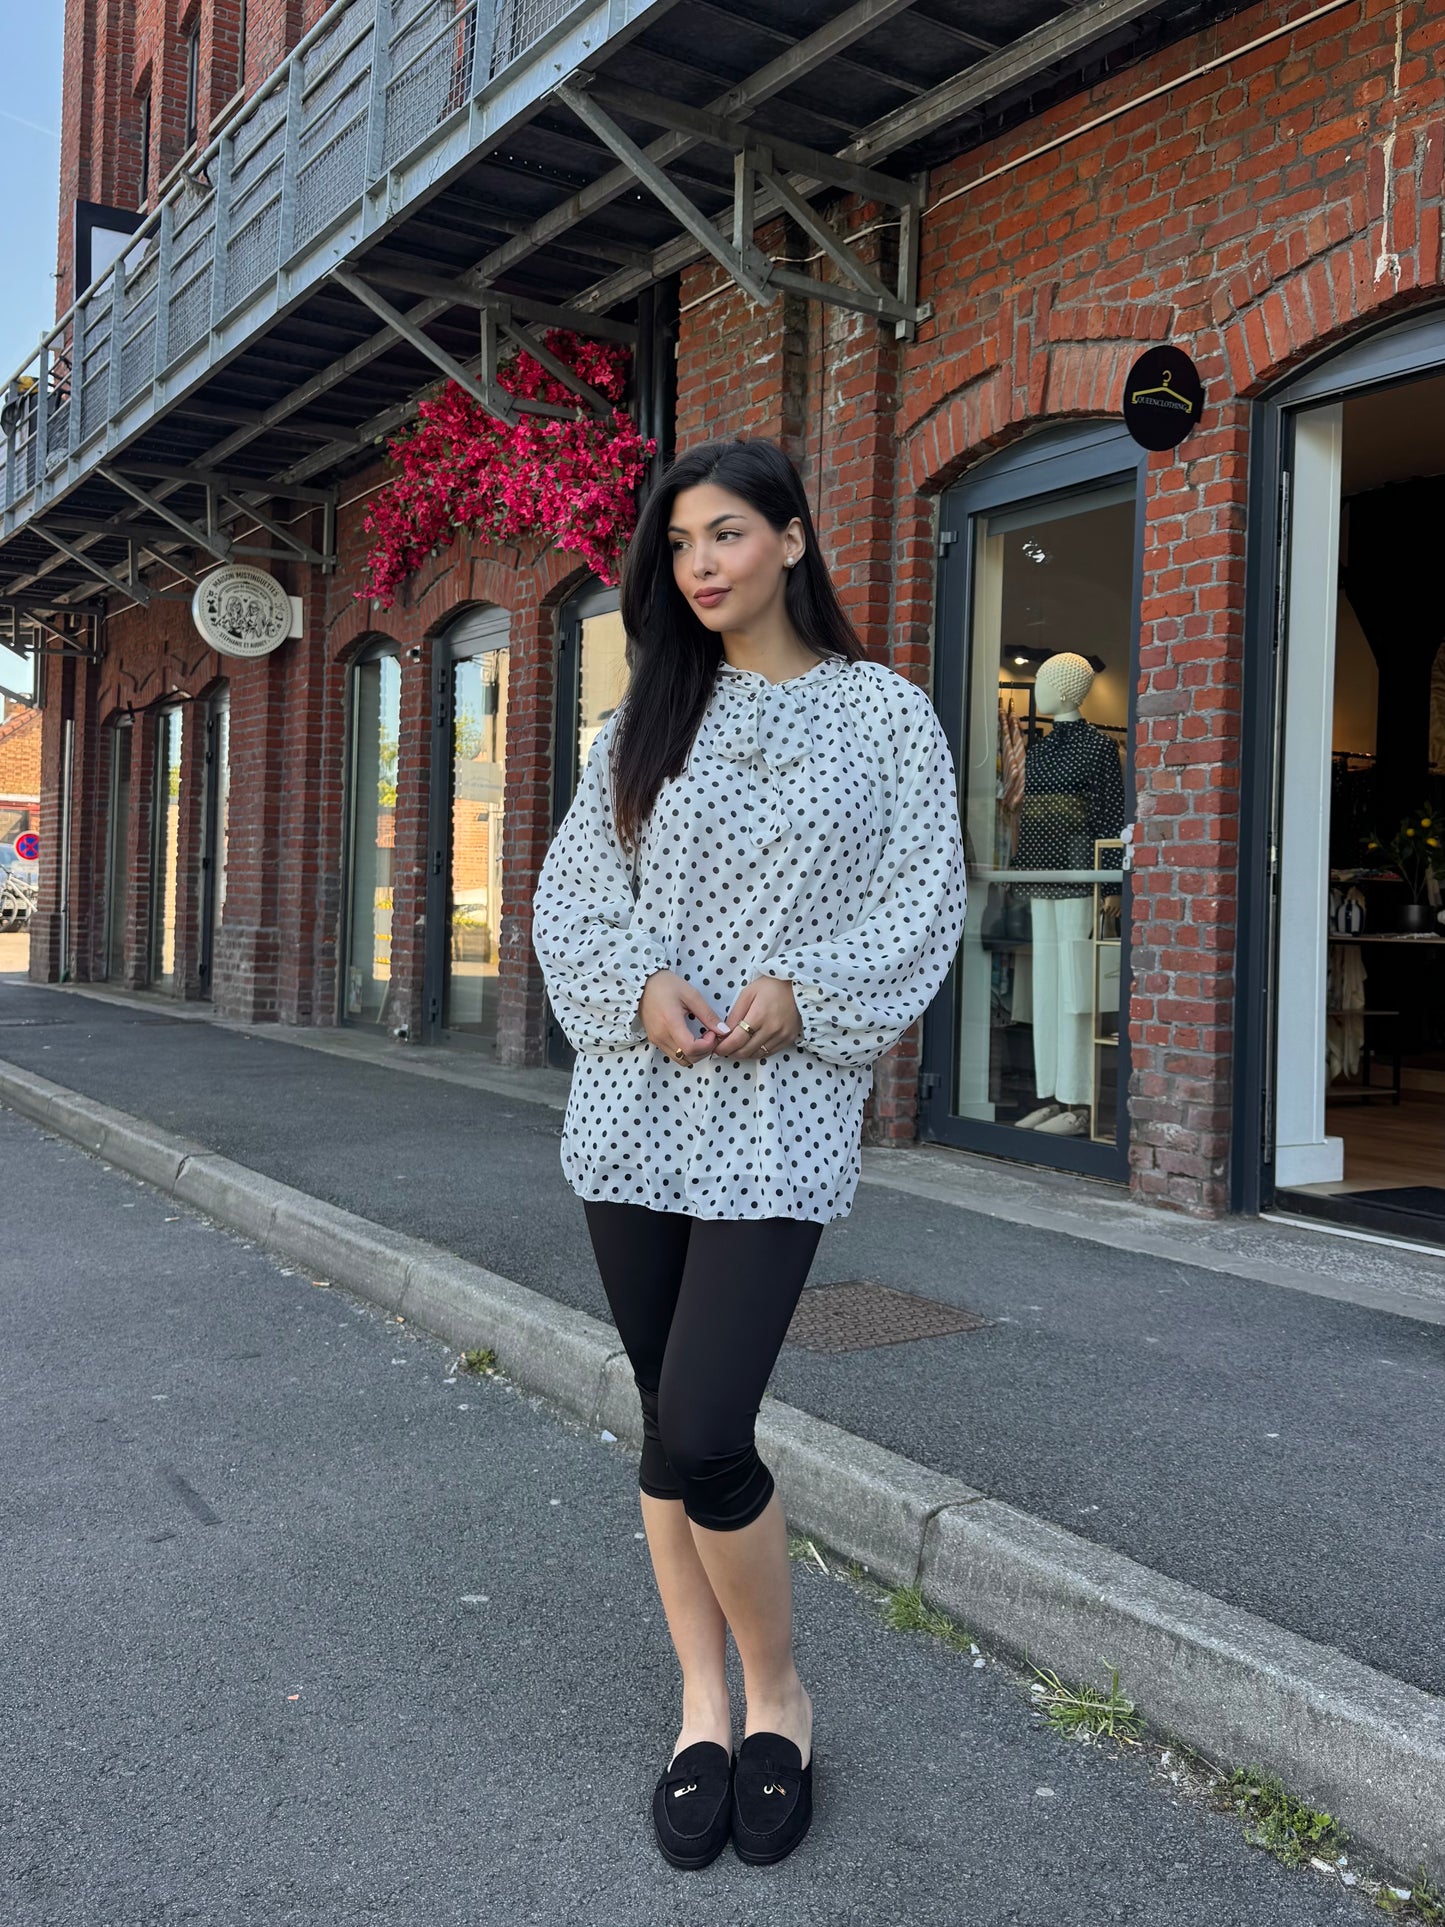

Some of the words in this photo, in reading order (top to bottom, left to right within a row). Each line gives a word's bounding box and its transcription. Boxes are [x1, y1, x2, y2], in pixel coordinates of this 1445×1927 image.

[1136, 396, 1187, 410] QUEENCLOTHING
[212, 572, 235, 587] MAISON
[236, 571, 278, 597] MISTINGUETTES
